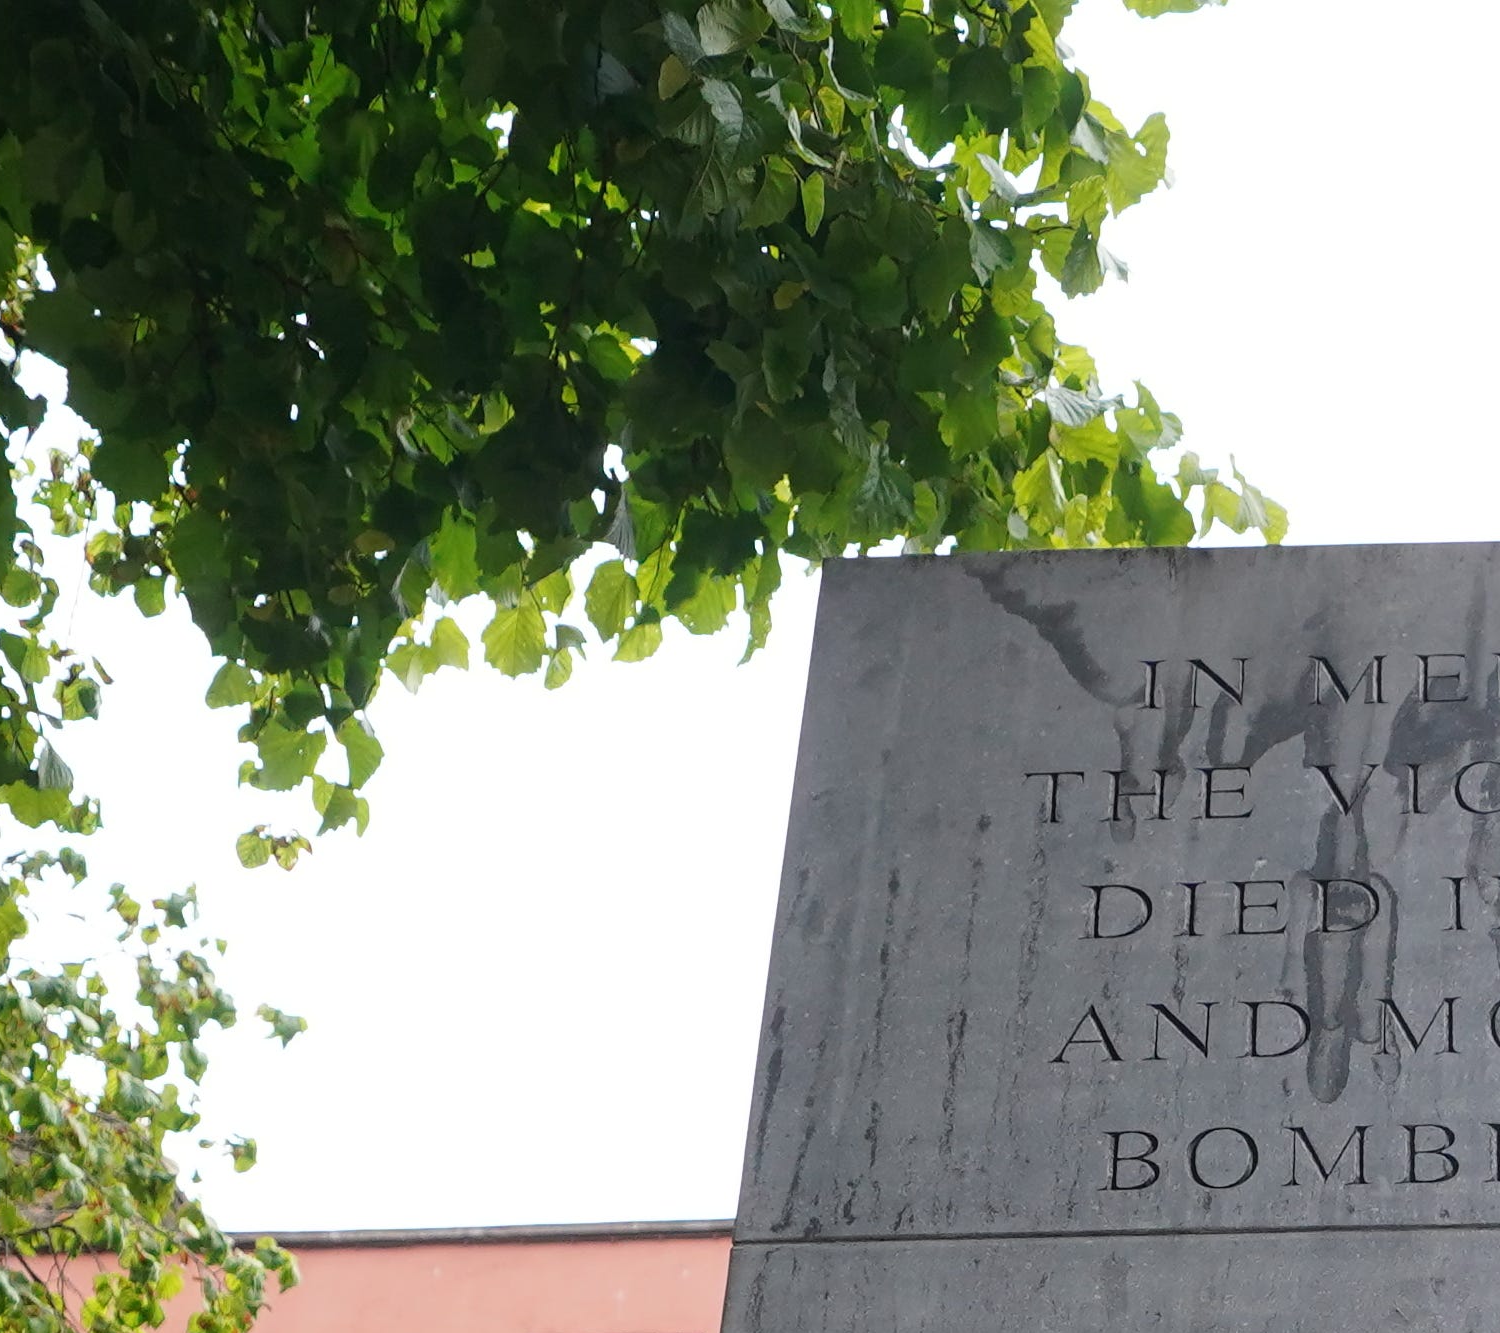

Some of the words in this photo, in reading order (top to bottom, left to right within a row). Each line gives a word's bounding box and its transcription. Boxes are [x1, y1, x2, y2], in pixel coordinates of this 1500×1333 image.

[1140, 657, 1250, 711] IN
[1027, 767, 1255, 825] THE
[1082, 878, 1383, 941] DIED
[1050, 1000, 1313, 1064] AND
